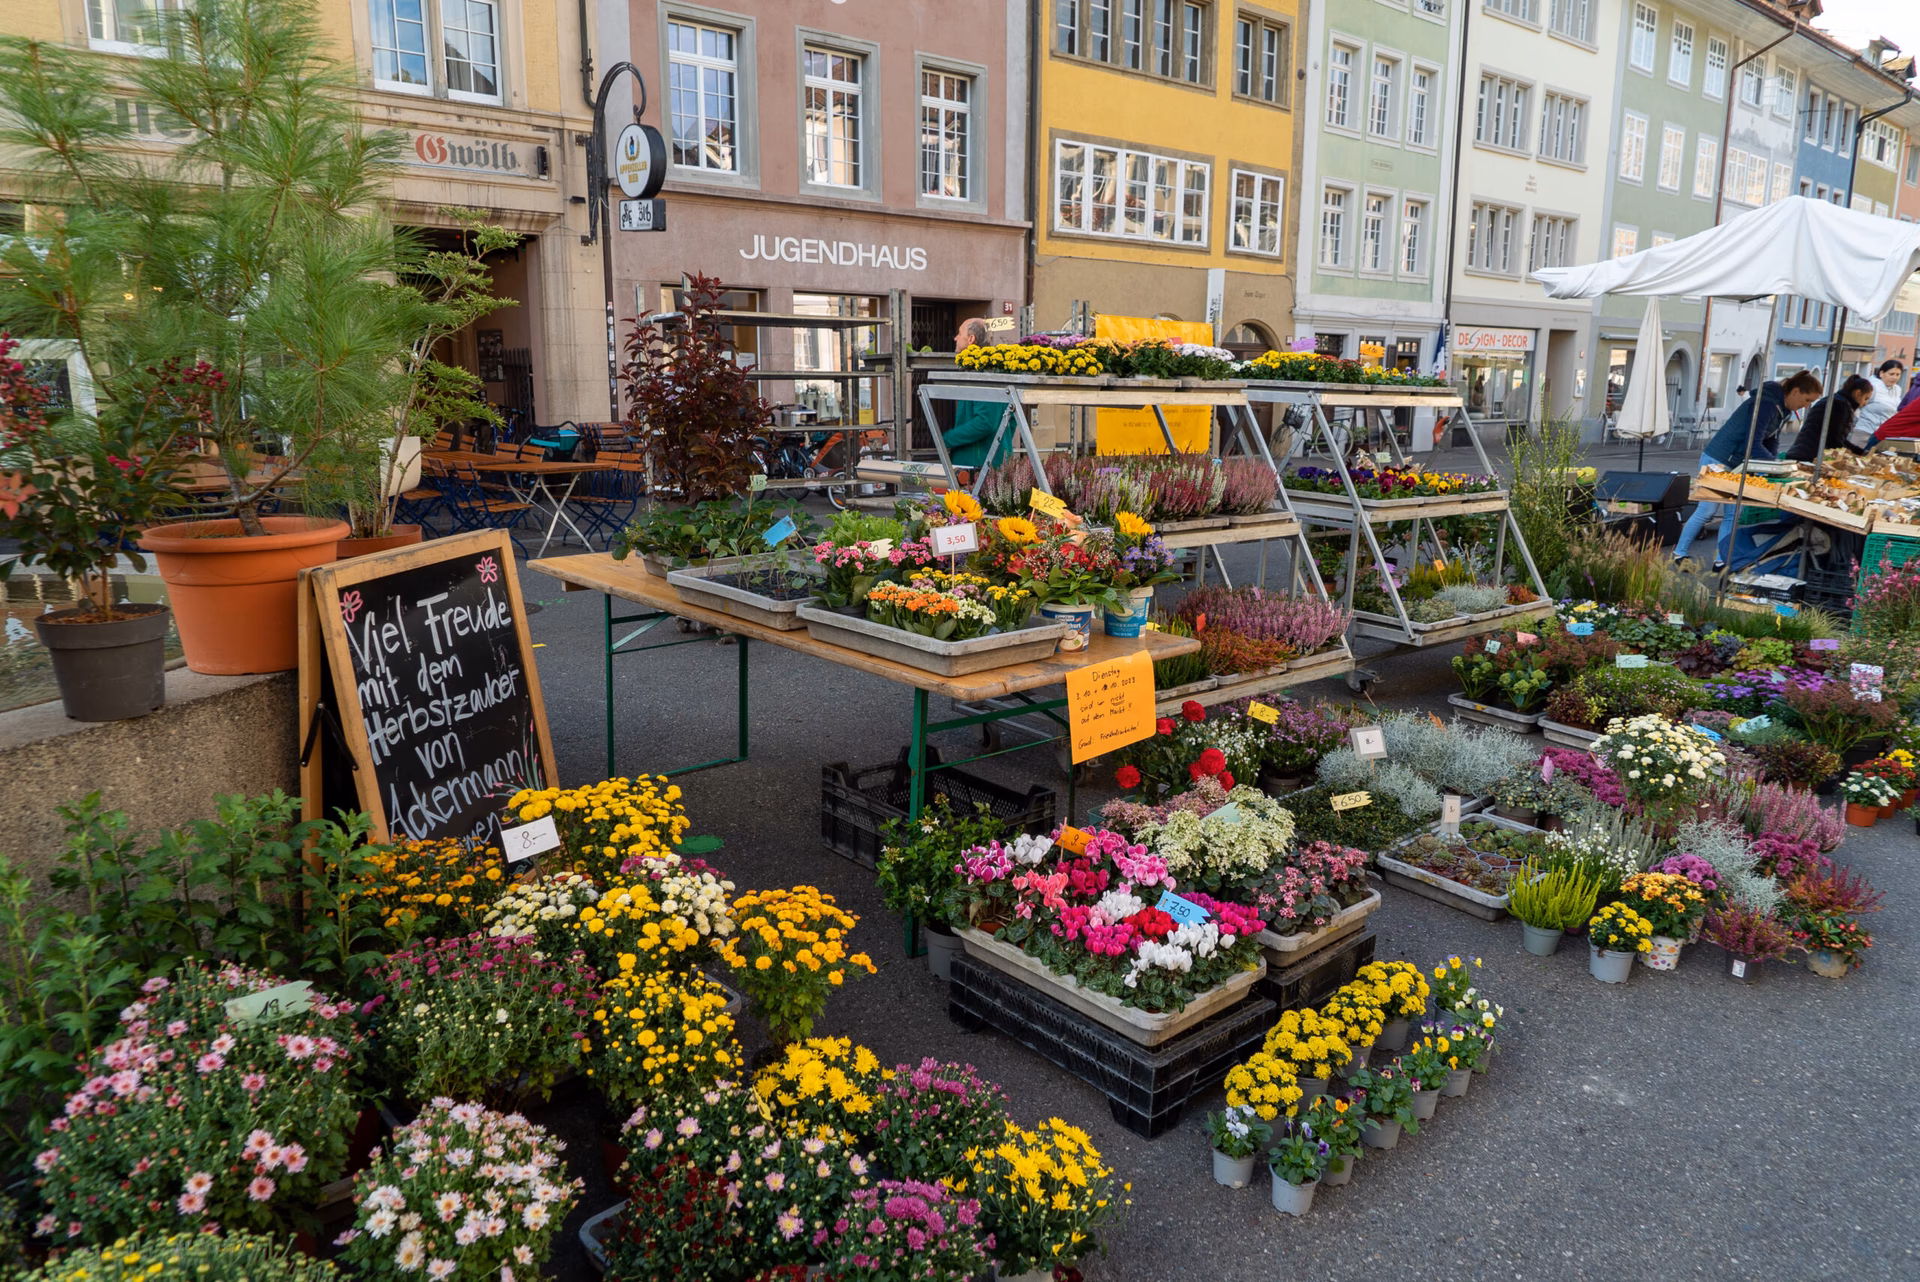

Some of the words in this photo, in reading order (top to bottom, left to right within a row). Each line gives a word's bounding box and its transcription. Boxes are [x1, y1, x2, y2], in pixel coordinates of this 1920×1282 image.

[415, 133, 517, 171] Gwölb
[739, 234, 927, 271] JUGENDHAUS
[1004, 302, 1013, 311] 31
[1458, 328, 1496, 352] DESIGN
[1502, 334, 1529, 348] DECOR
[946, 534, 967, 546] 3,50
[344, 595, 411, 674] Viel
[417, 586, 511, 654] Freude
[357, 665, 400, 709] mit
[417, 652, 462, 695] dem
[1092, 665, 1120, 682] Dienstag
[364, 669, 519, 766] Herbstzauber
[415, 731, 466, 779] von
[389, 750, 525, 842] Ackermann
